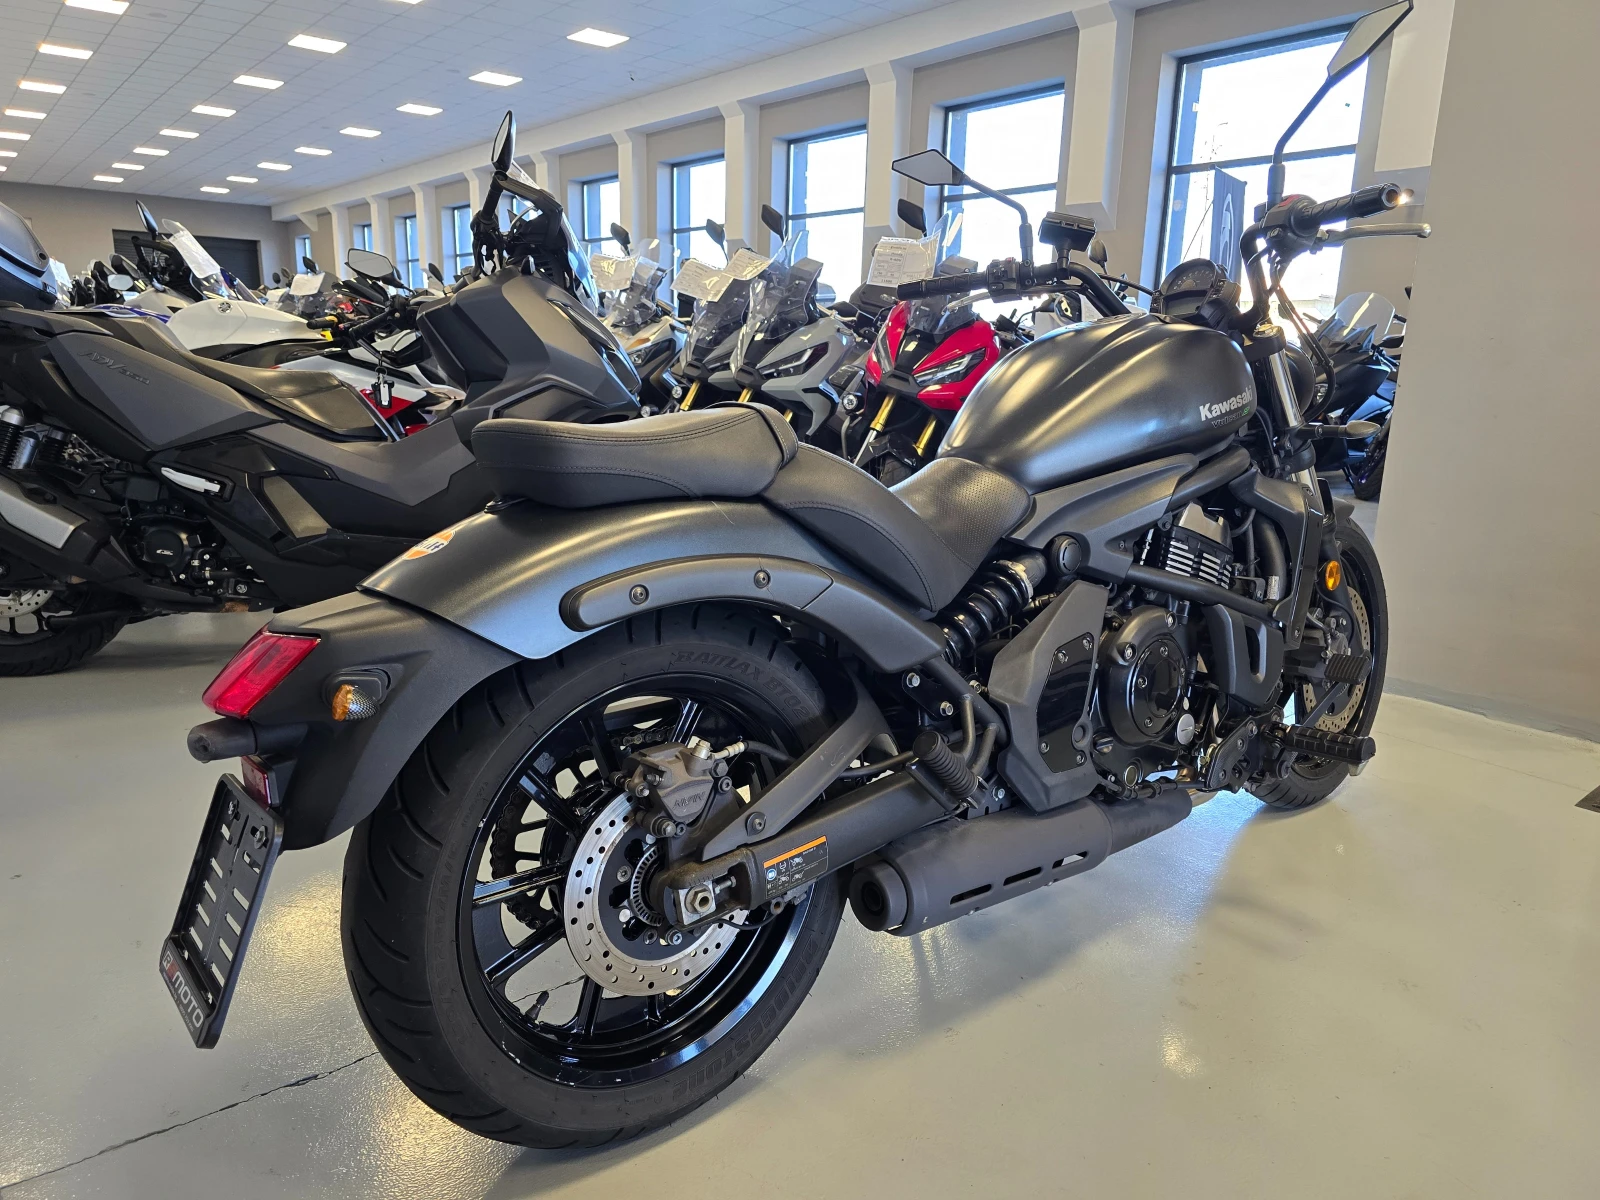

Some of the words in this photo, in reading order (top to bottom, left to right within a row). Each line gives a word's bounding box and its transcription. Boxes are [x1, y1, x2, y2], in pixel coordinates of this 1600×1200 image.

[1199, 385, 1253, 421] Kawasaki
[674, 650, 764, 682] BATTLAX
[763, 676, 814, 722] BT02
